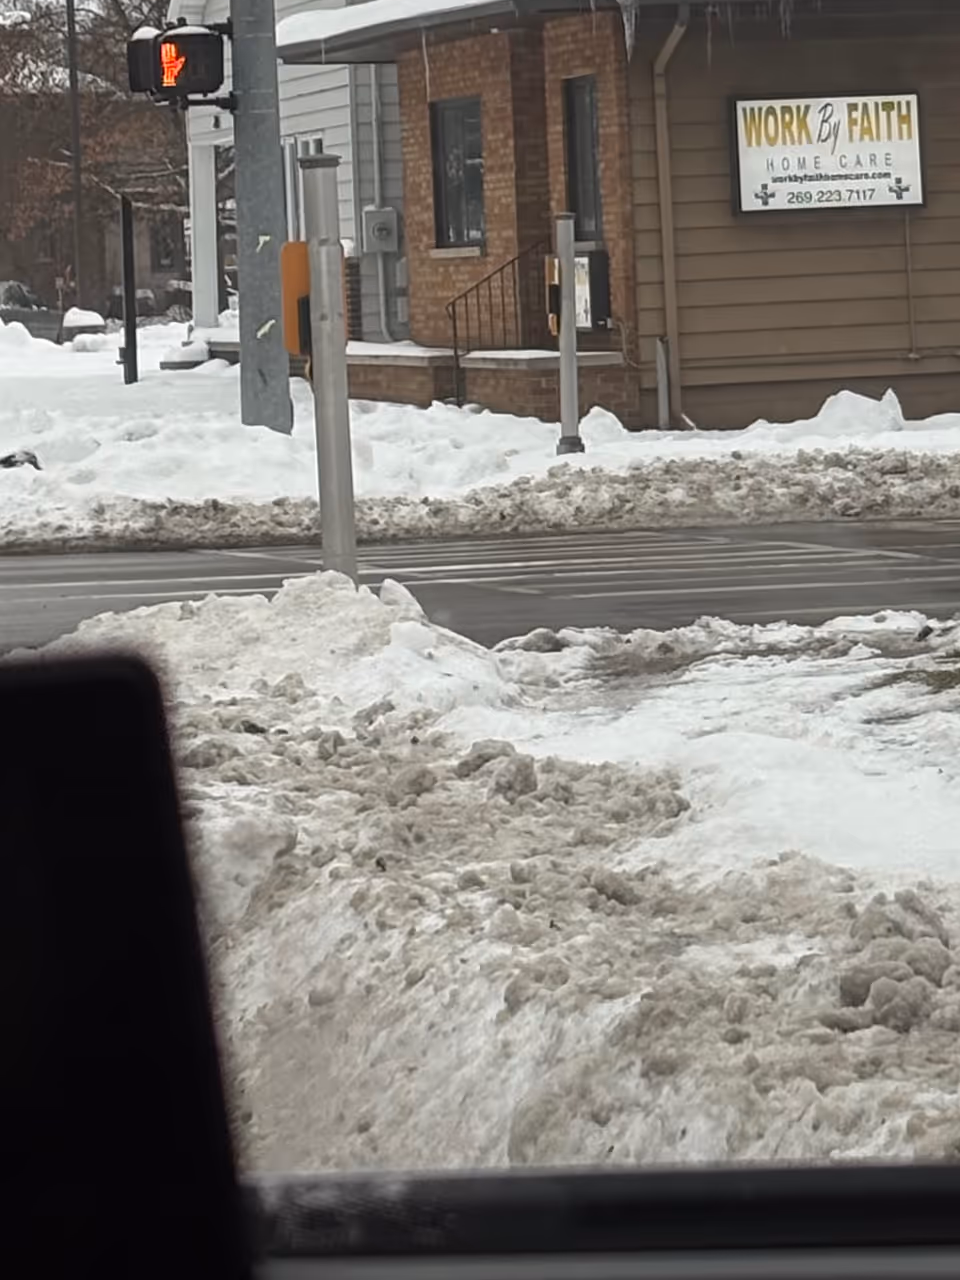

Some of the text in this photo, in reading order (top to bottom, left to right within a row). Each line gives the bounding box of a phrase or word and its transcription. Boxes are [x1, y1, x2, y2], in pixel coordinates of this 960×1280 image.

[742, 100, 913, 156] WORK By FAITH
[766, 152, 893, 172] HOME CARE
